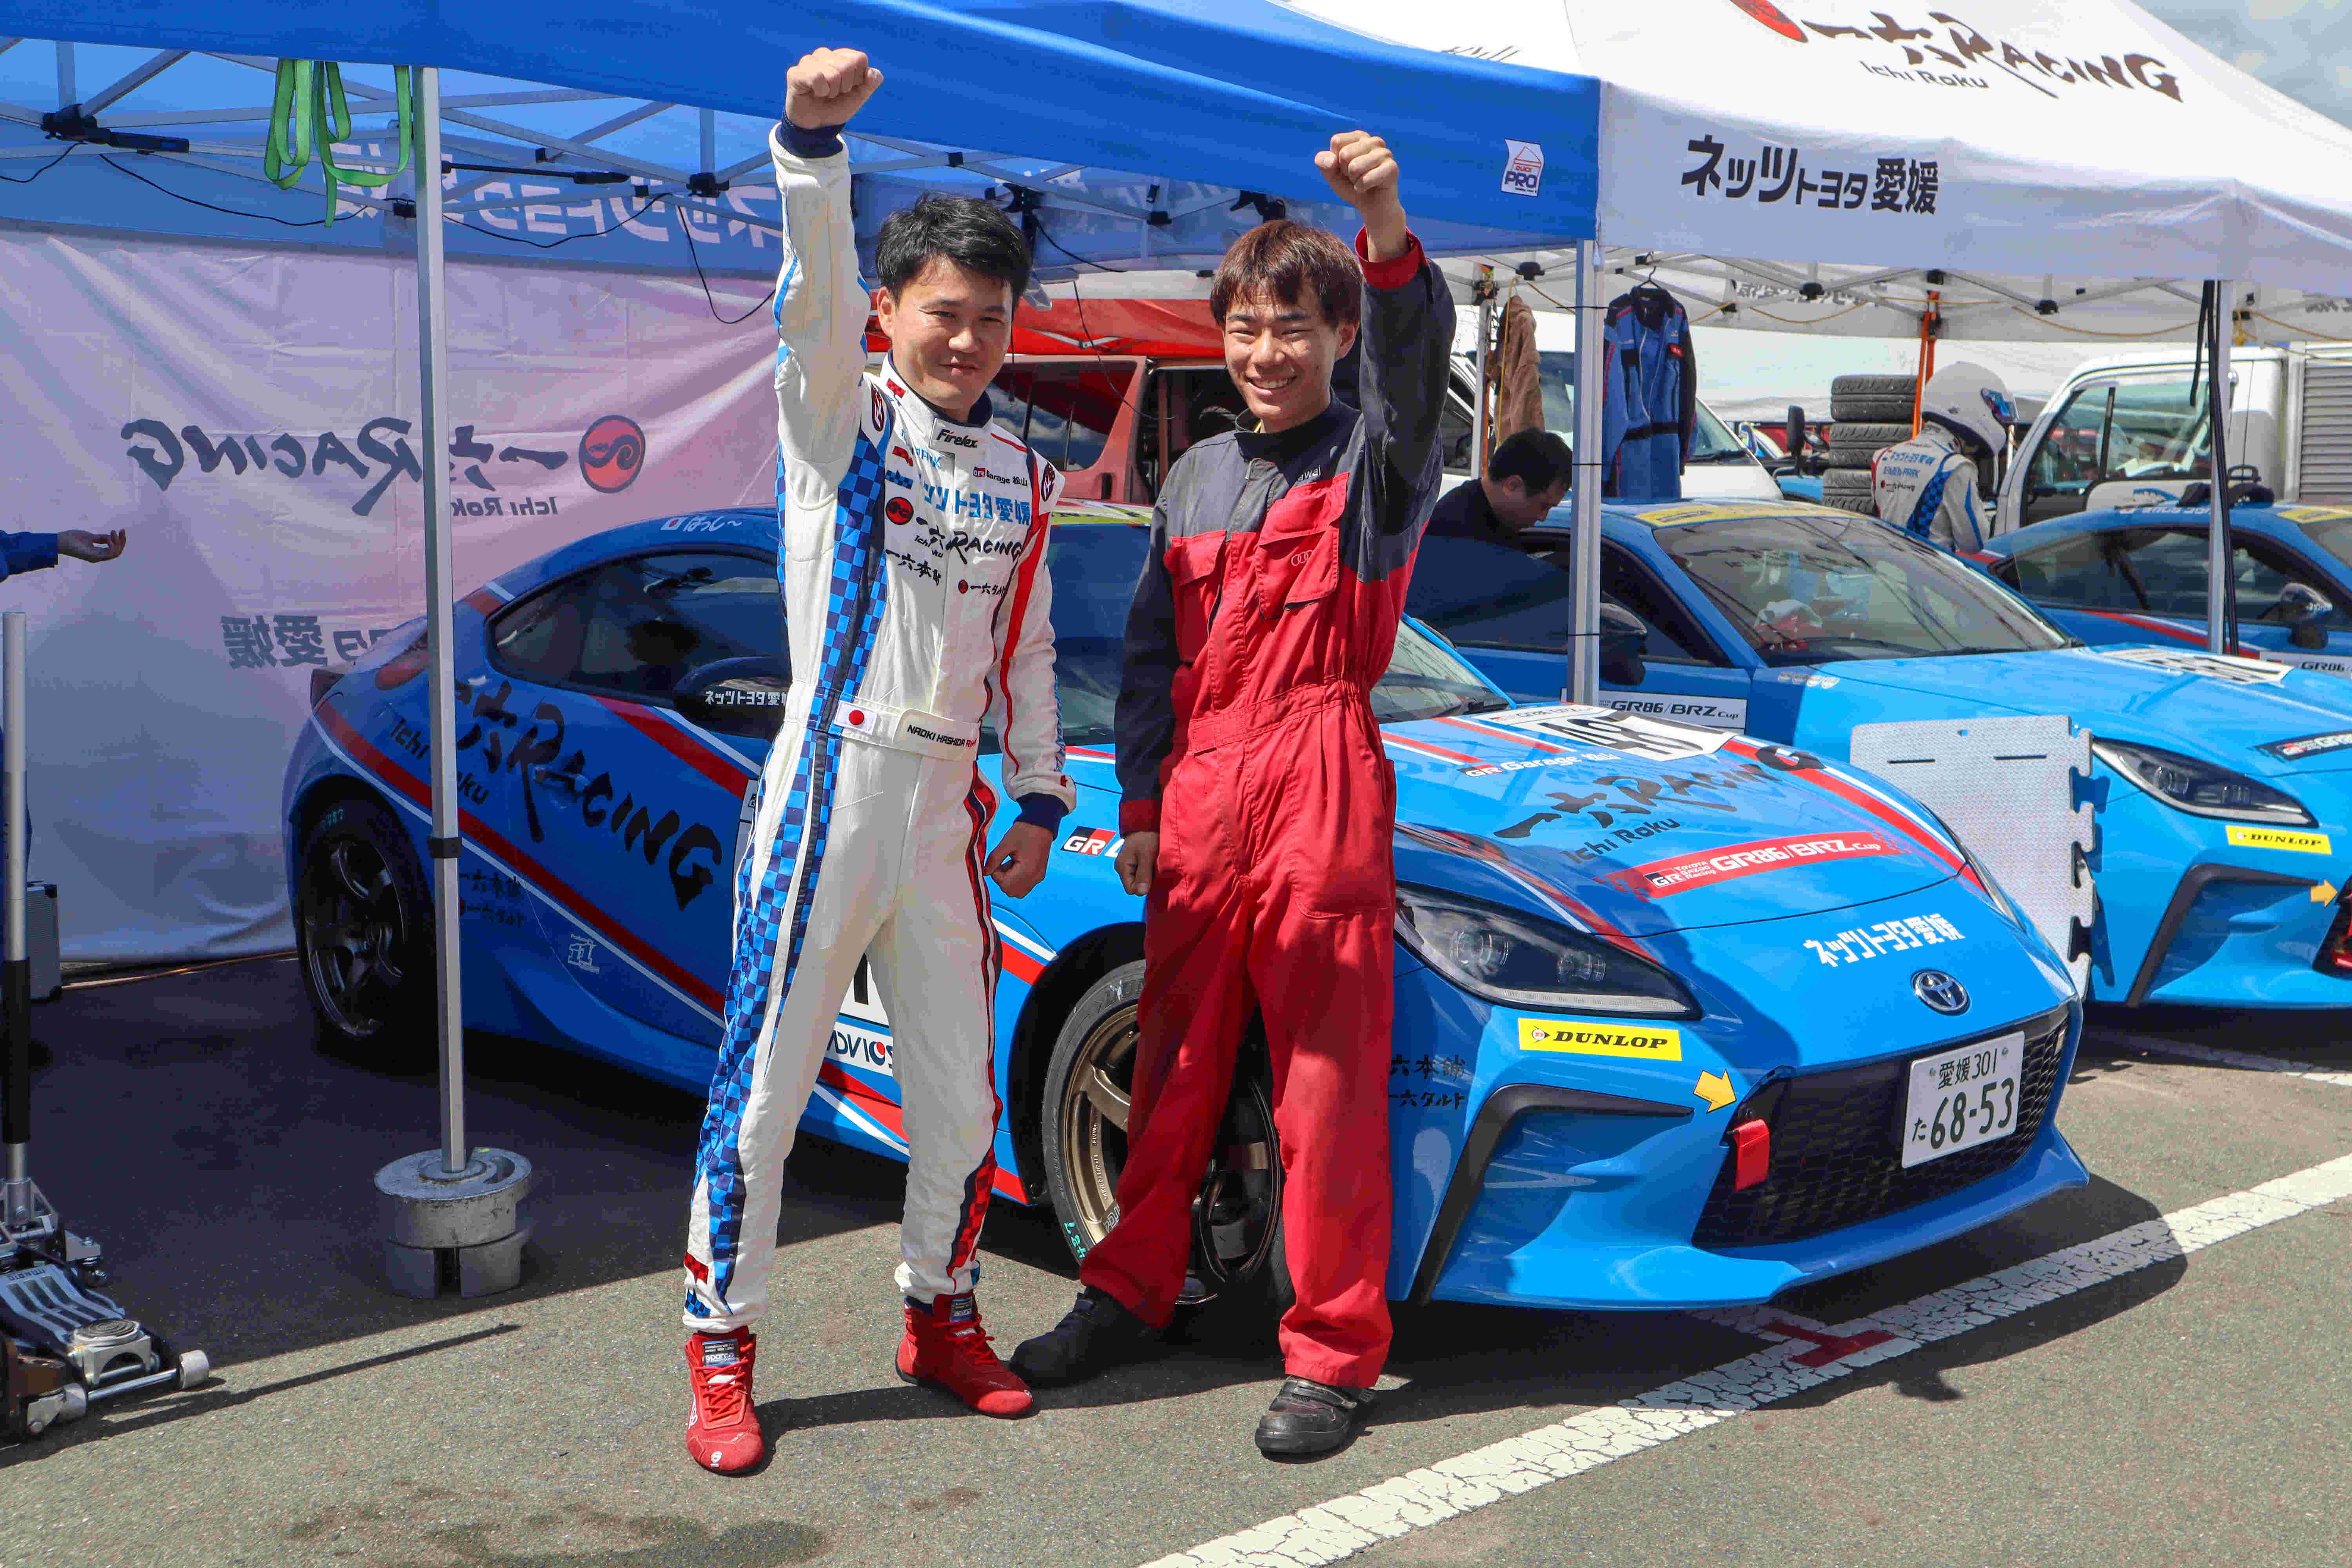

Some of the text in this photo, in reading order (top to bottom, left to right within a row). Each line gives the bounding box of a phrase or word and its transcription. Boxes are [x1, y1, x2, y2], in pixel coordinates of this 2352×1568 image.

[1859, 60, 1989, 89] Ichi Roku
[1504, 171, 1537, 188] PRO
[1681, 134, 1938, 215] ネッツトヨタ愛媛
[936, 429, 978, 448] Firelex
[986, 470, 1010, 484] Garage
[1717, 711, 1739, 720] Cup
[907, 724, 936, 740] NAOKI
[936, 734, 965, 747] HASHIDA
[1465, 767, 1503, 777] GR
[1500, 755, 1582, 771] Garage
[1063, 835, 1106, 855] GR
[1560, 817, 1681, 864] Ichi Roku
[2250, 833, 2321, 847] DUNLOP
[1710, 839, 1881, 872] GR86/BRZ Cup
[1652, 873, 1686, 887] GR
[1803, 913, 1966, 967] ネッツトヨタ愛媛
[1553, 1031, 1668, 1049] DUNLOP
[1390, 1053, 1467, 1082] 六本舗
[1911, 1077, 2014, 1149] た 68-53
